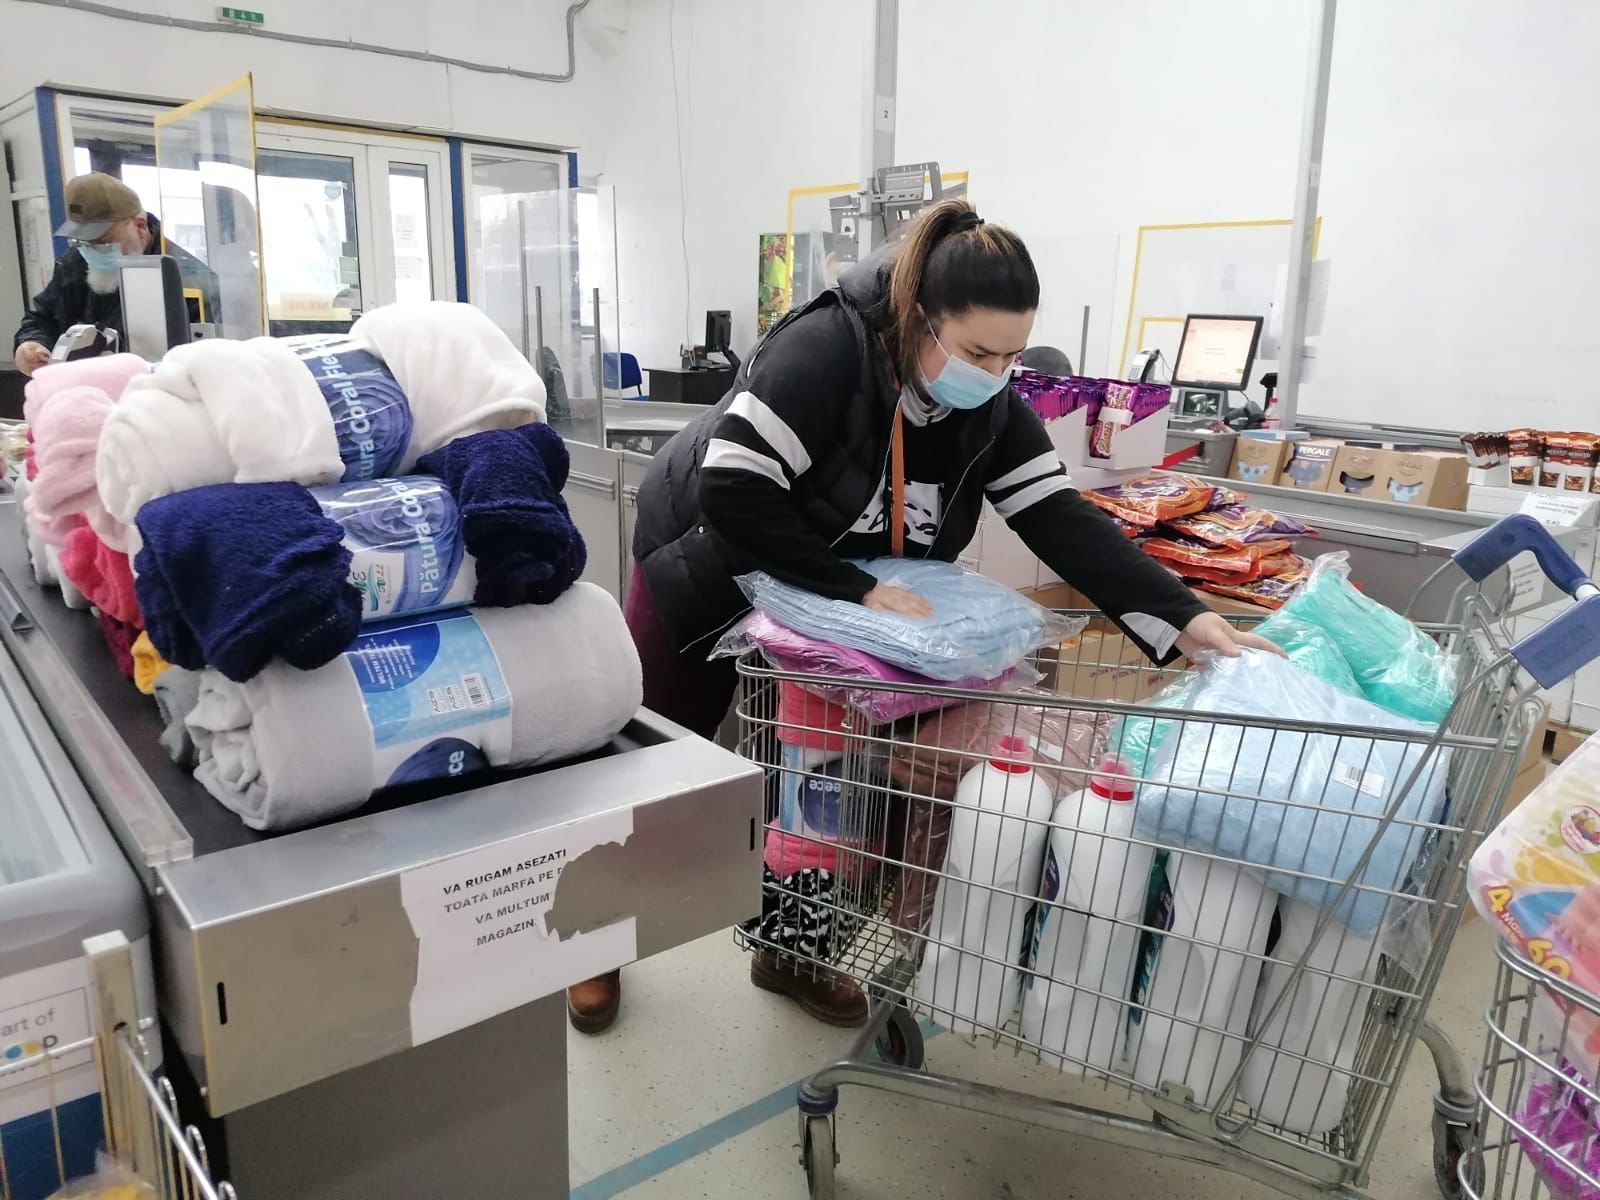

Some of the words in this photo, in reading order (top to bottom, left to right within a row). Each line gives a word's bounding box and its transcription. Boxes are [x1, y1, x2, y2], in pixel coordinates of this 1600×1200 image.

[321, 355, 348, 380] Fle
[332, 381, 370, 435] Coral
[357, 439, 375, 479] tura
[1298, 446, 1332, 457] PERGALE
[415, 522, 439, 594] Pătura
[809, 779, 842, 793] eece
[443, 883, 461, 896] VA
[465, 866, 512, 889] RUGAM
[515, 848, 567, 873] ASEZATI
[444, 892, 489, 913] TOATA
[492, 877, 536, 898] MARFA
[538, 870, 554, 883] PE
[1488, 886, 1513, 913] 4
[475, 912, 493, 925] VA
[496, 892, 551, 917] MULTUM
[476, 918, 535, 947] MAGAZIN
[0, 1017, 30, 1037] art
[35, 1007, 56, 1027] of
